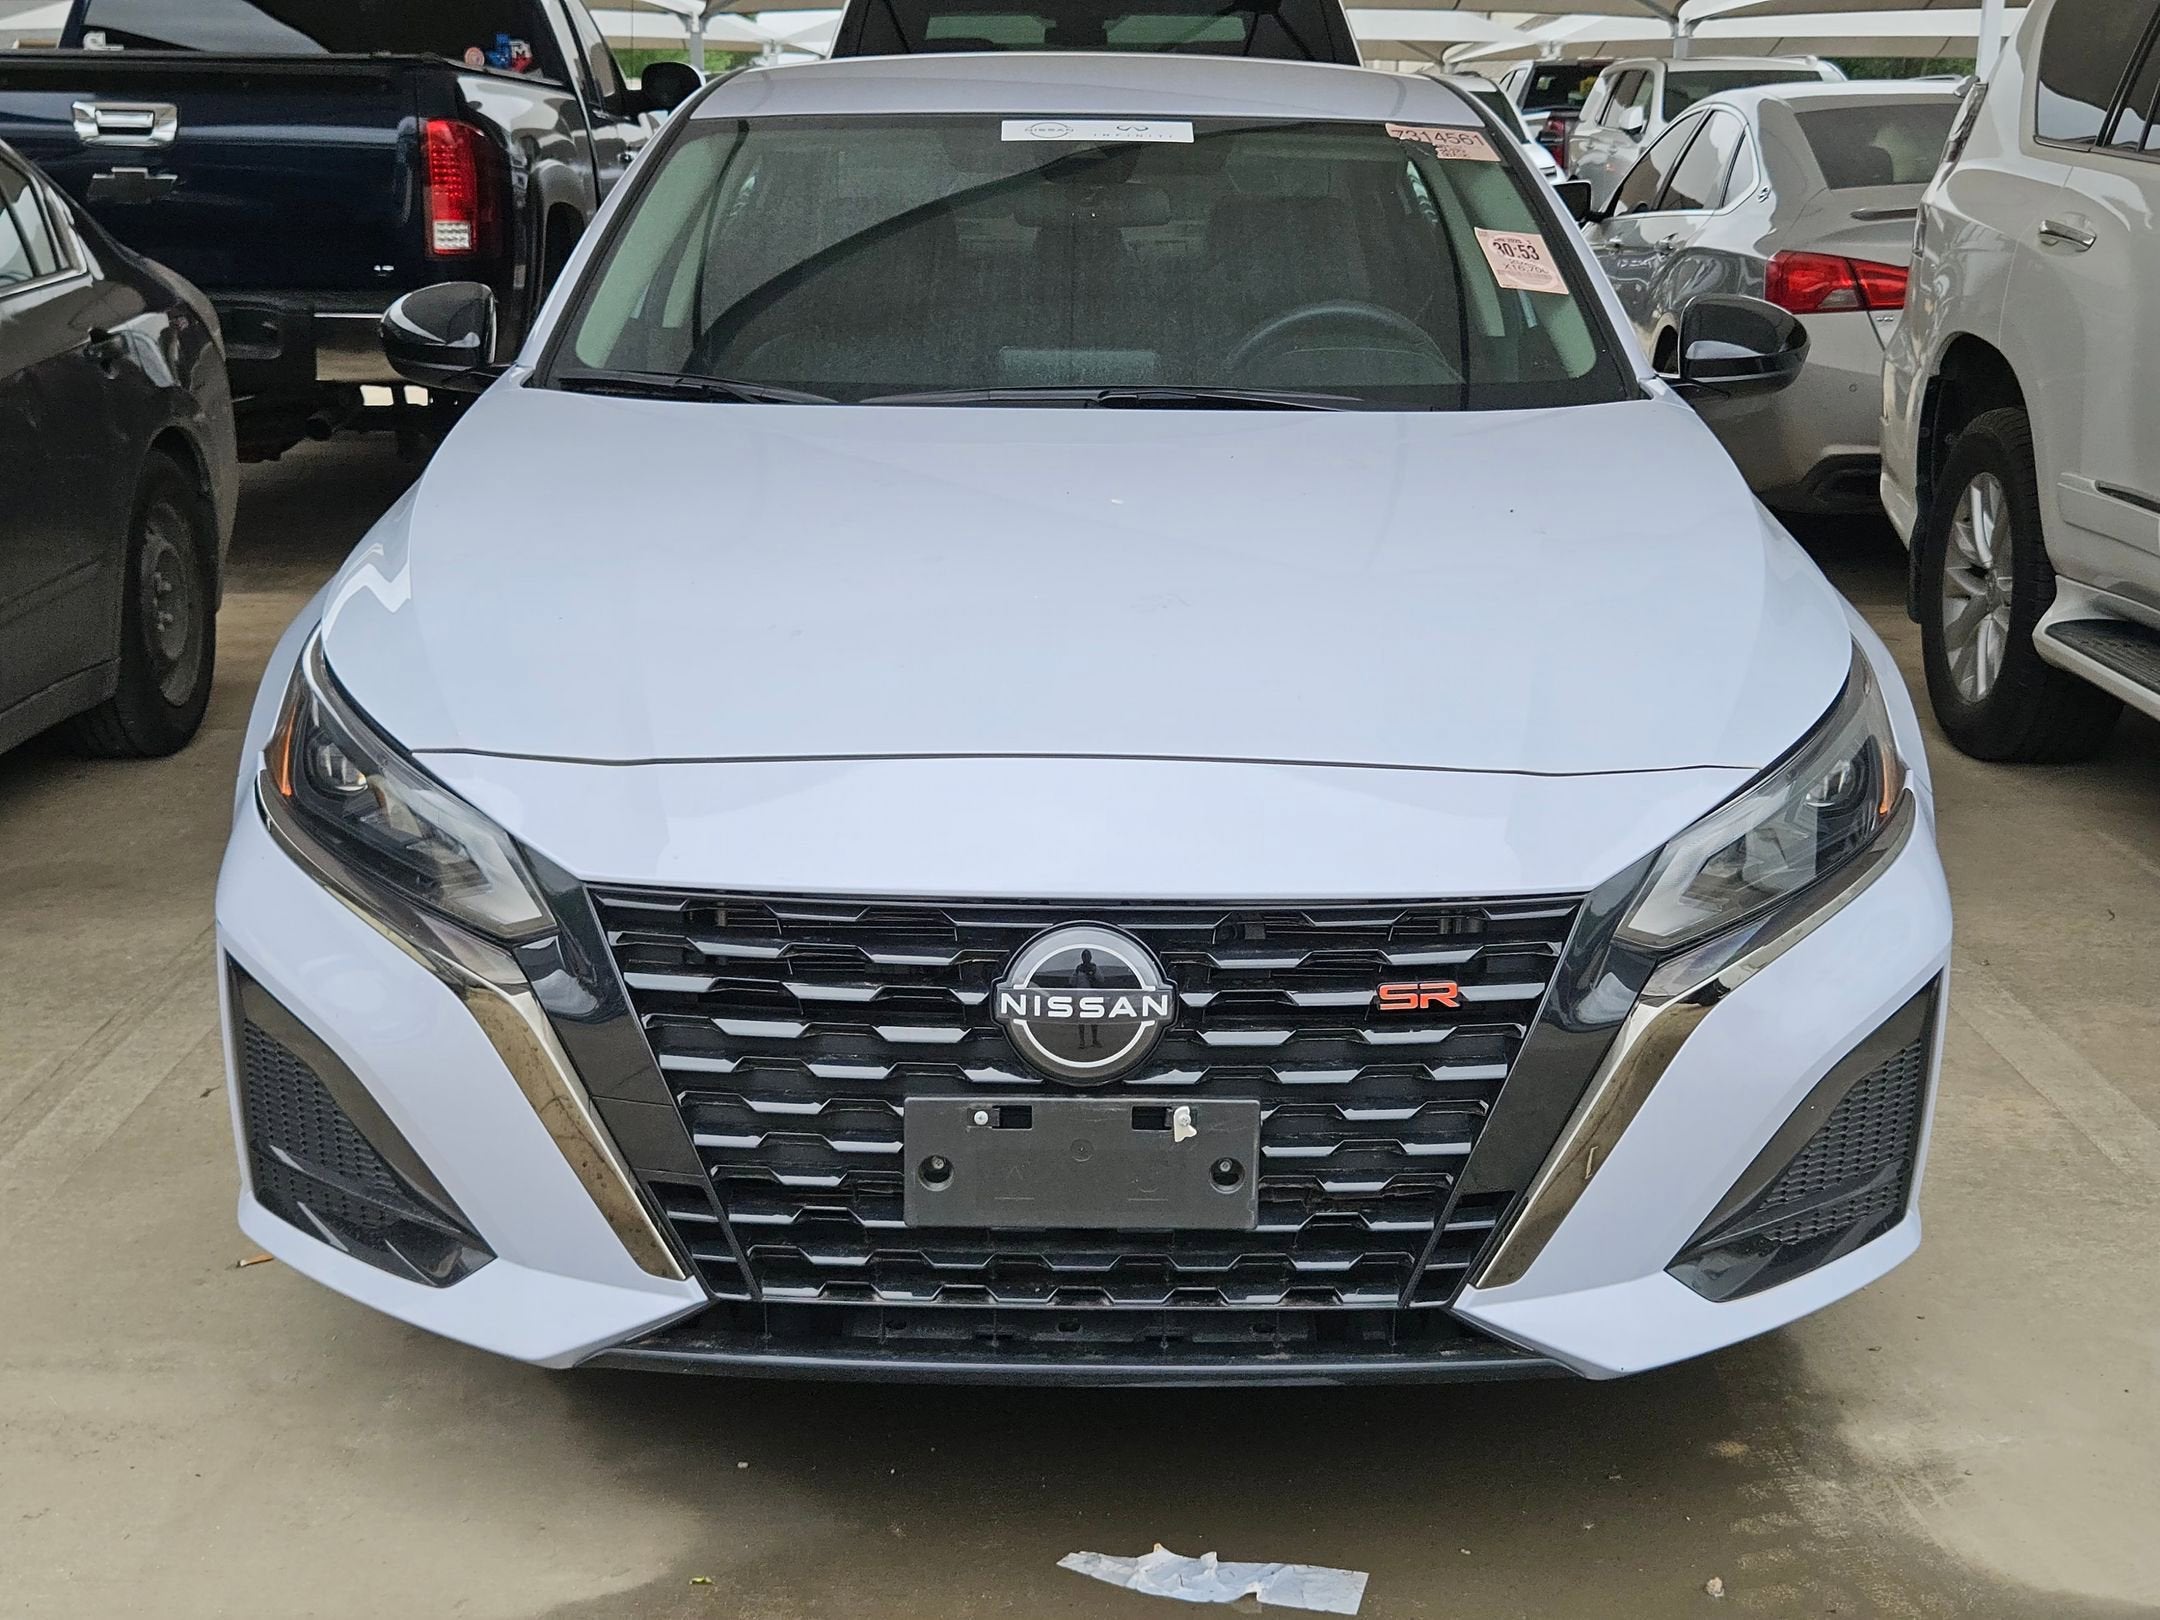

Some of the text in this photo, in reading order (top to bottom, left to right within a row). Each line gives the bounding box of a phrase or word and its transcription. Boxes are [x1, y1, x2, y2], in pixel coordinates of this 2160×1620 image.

[1390, 129, 1485, 146] 7314561
[1000, 992, 1170, 1019] NISSAN
[1378, 981, 1459, 1011] SR
